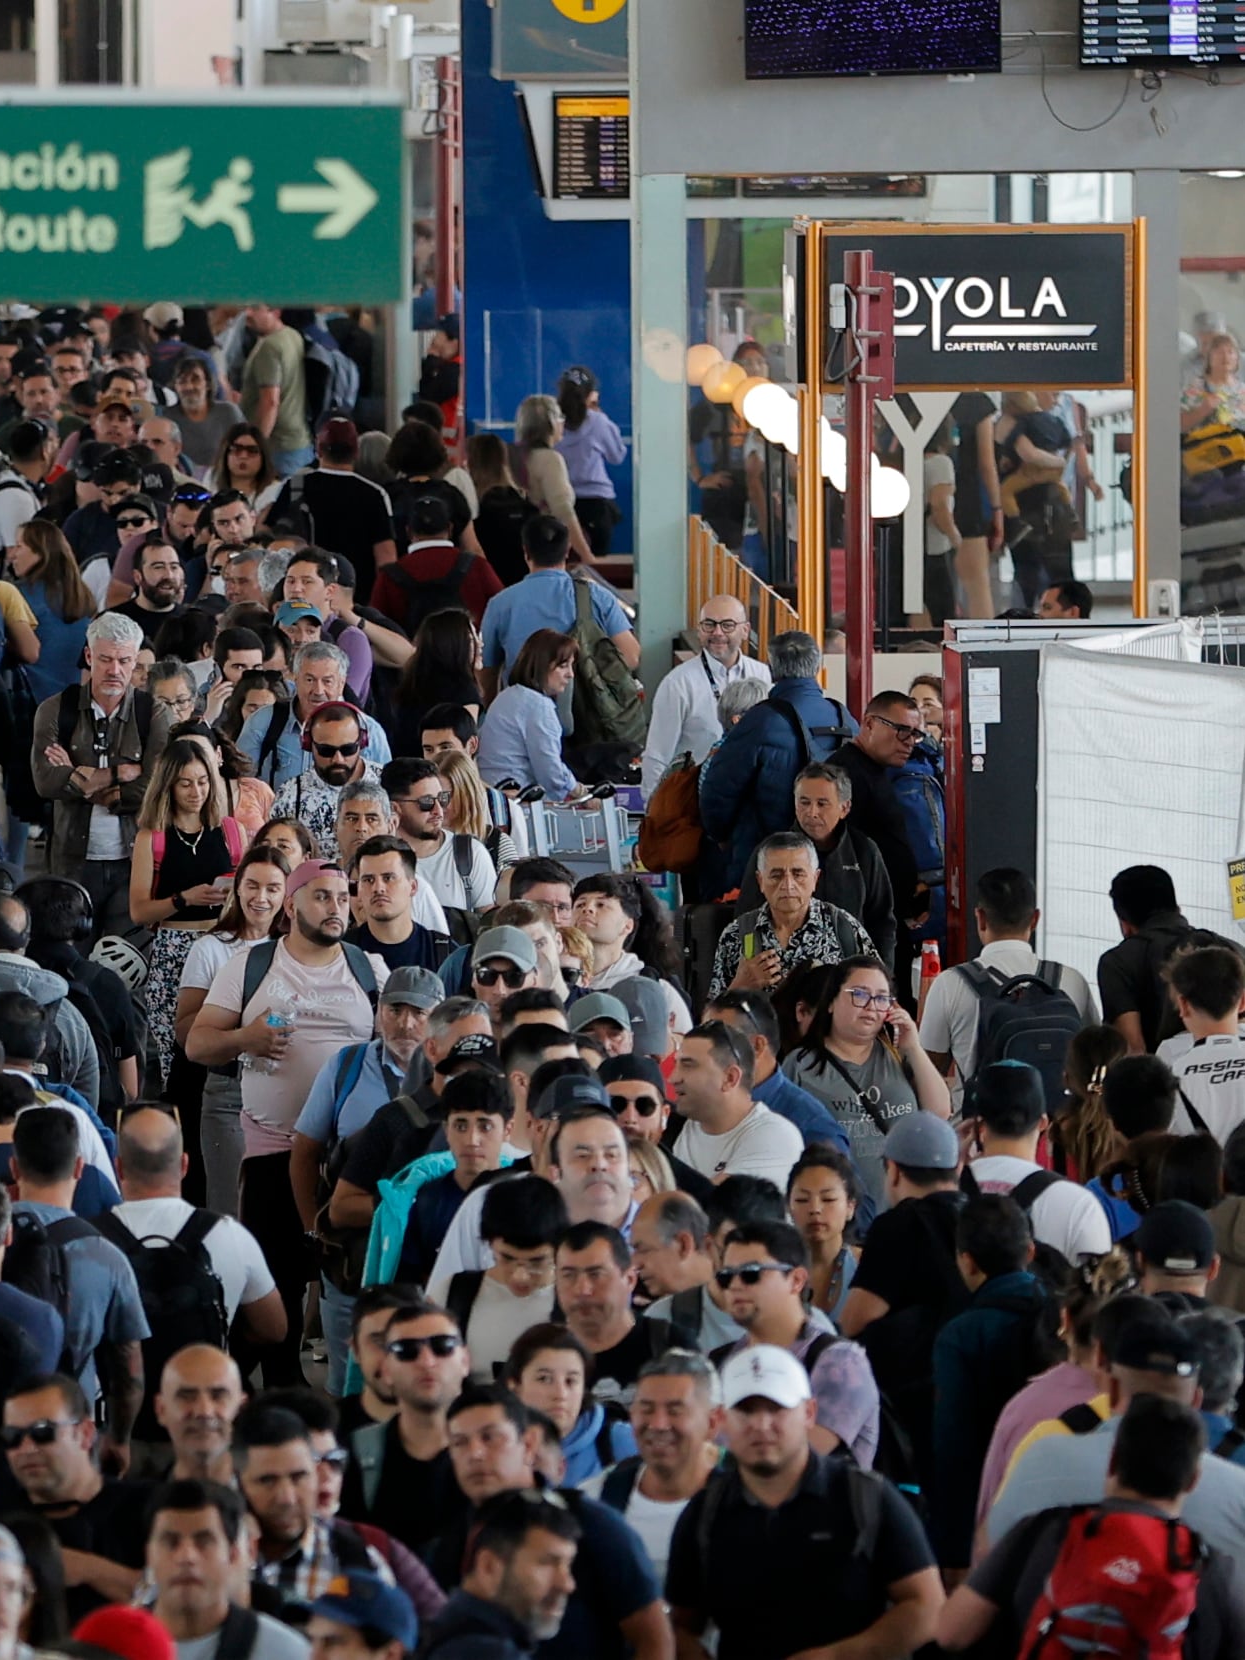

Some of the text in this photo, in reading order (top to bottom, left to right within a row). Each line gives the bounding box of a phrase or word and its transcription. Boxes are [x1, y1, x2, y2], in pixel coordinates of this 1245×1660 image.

[893, 277, 1068, 351] OYOLA
[944, 340, 1099, 352] CAFETERÍA Y RESTAURANTE
